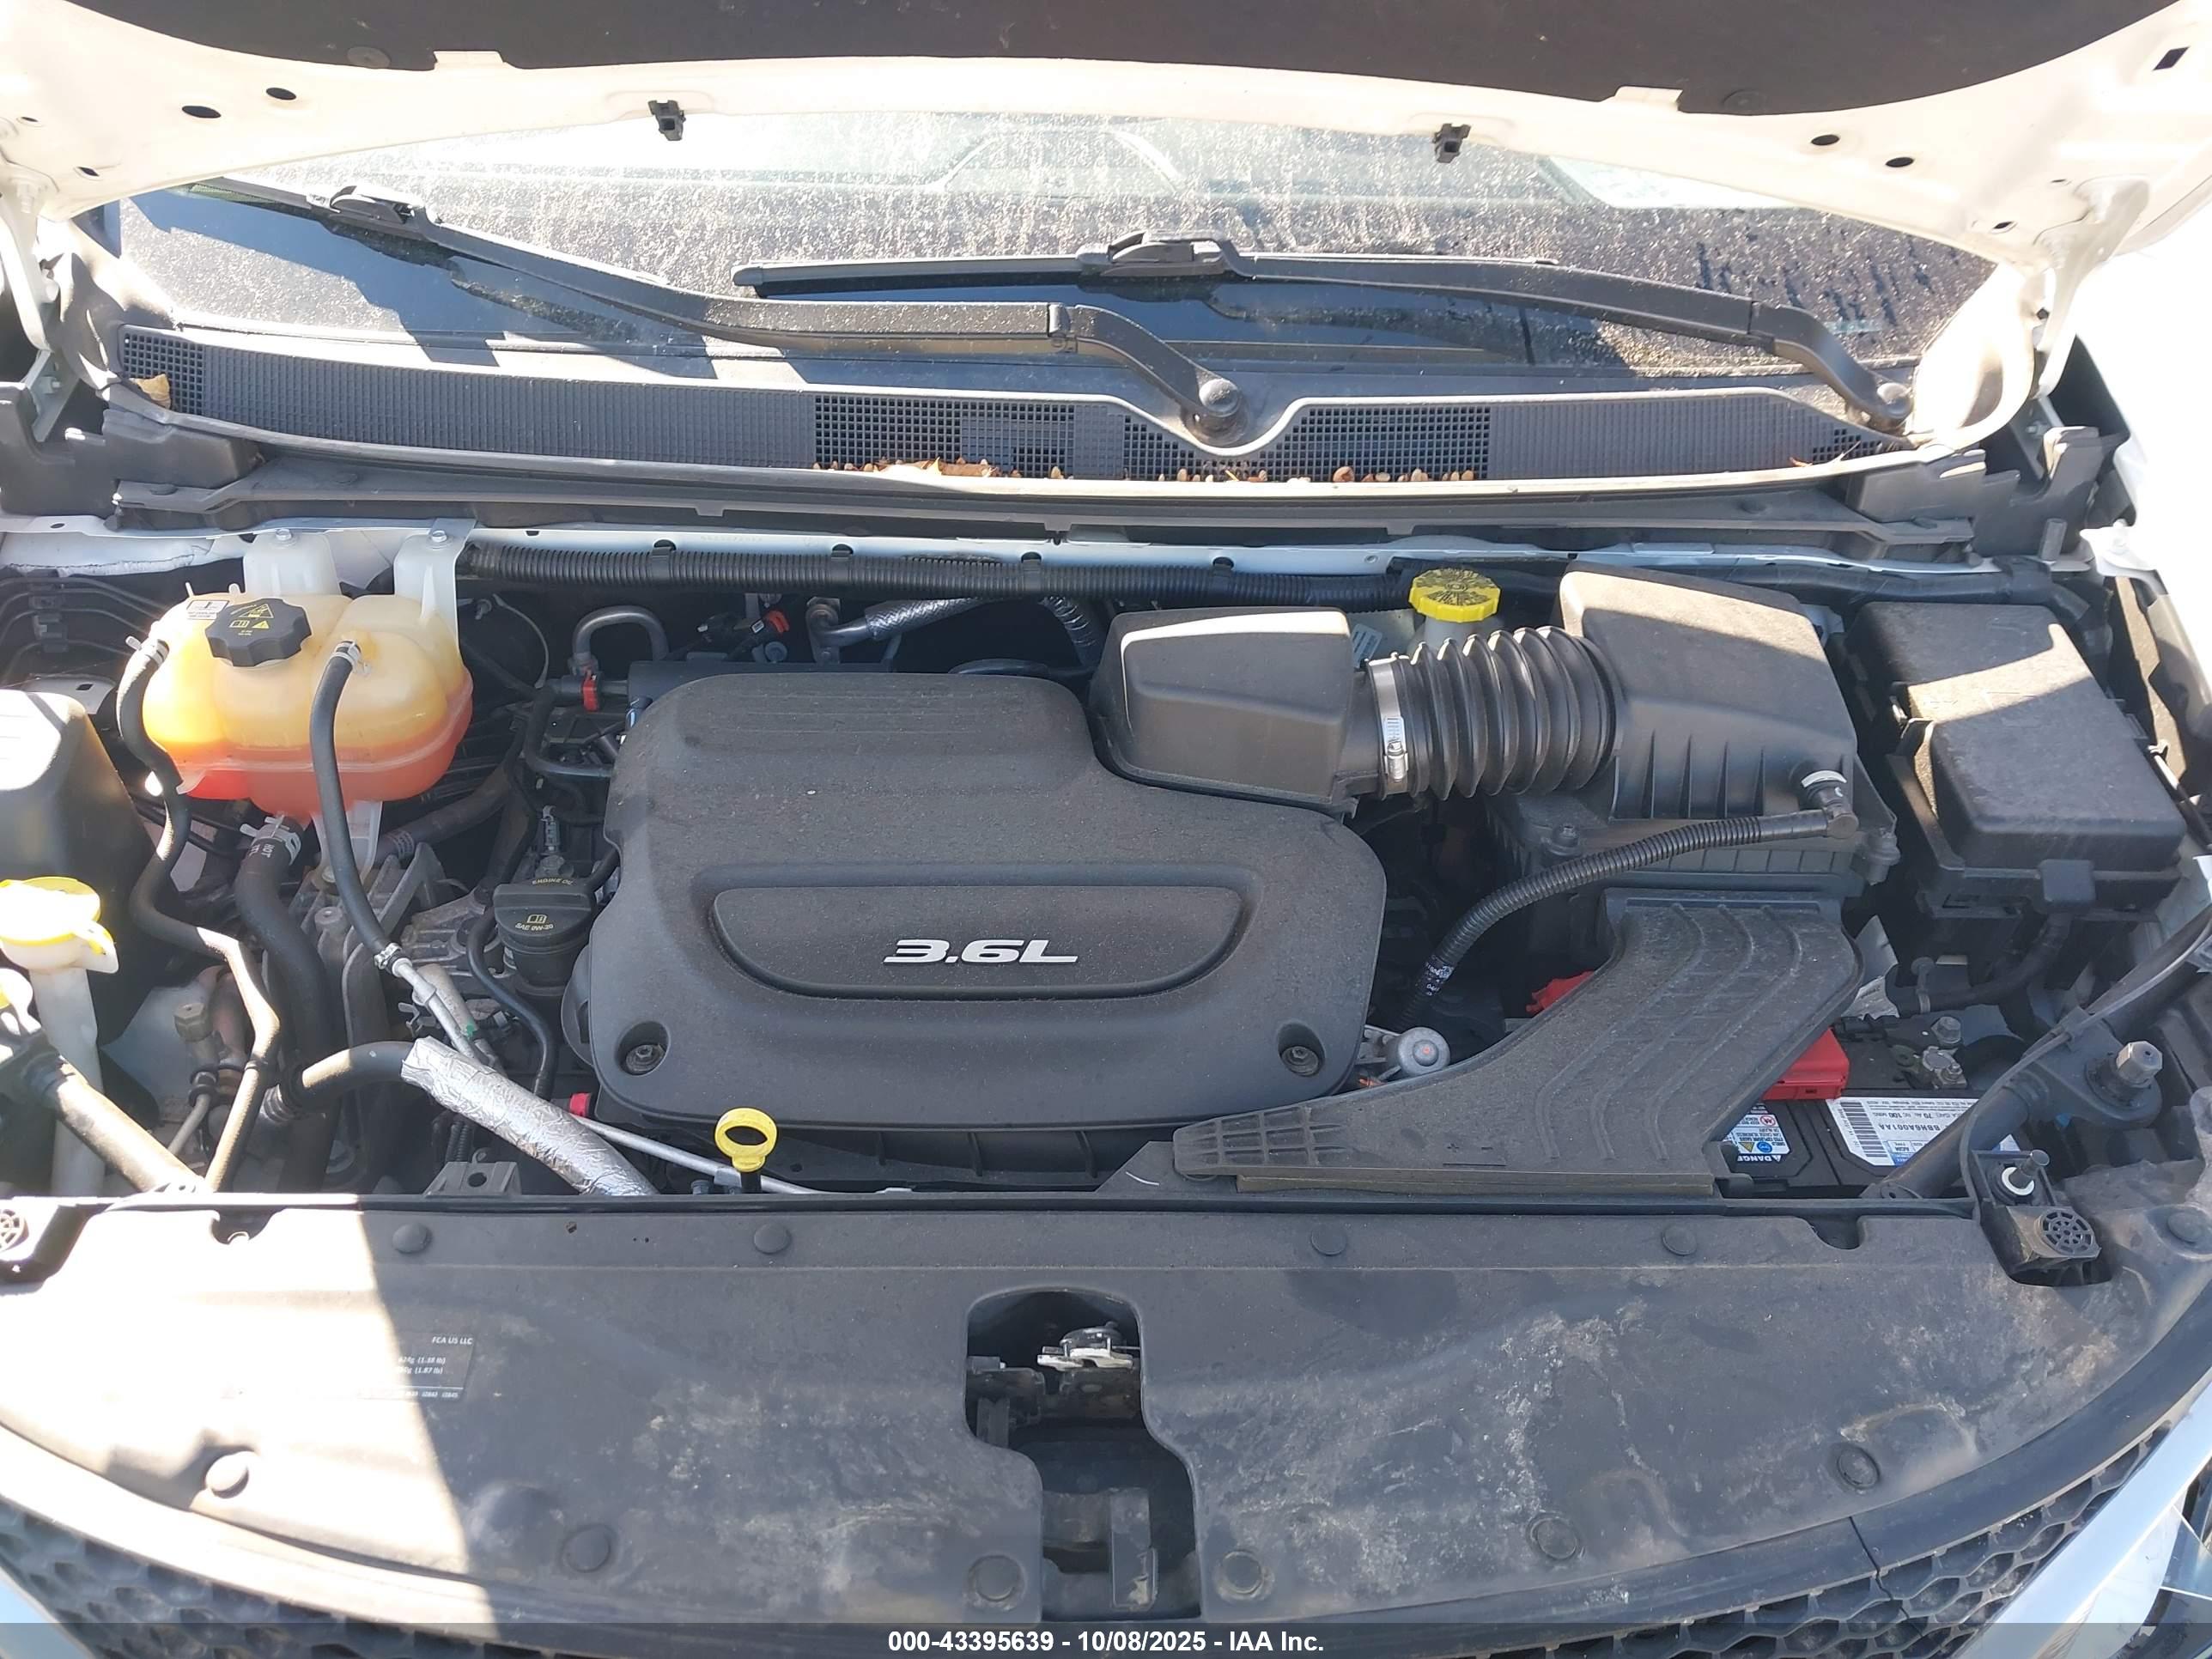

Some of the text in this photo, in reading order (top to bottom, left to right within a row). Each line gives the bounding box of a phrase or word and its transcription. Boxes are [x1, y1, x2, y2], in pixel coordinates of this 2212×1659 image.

[514, 922, 531, 931] SAE
[883, 939, 1079, 963] 3.6L
[431, 1336, 447, 1345] FCA
[459, 1337, 473, 1346] LLC
